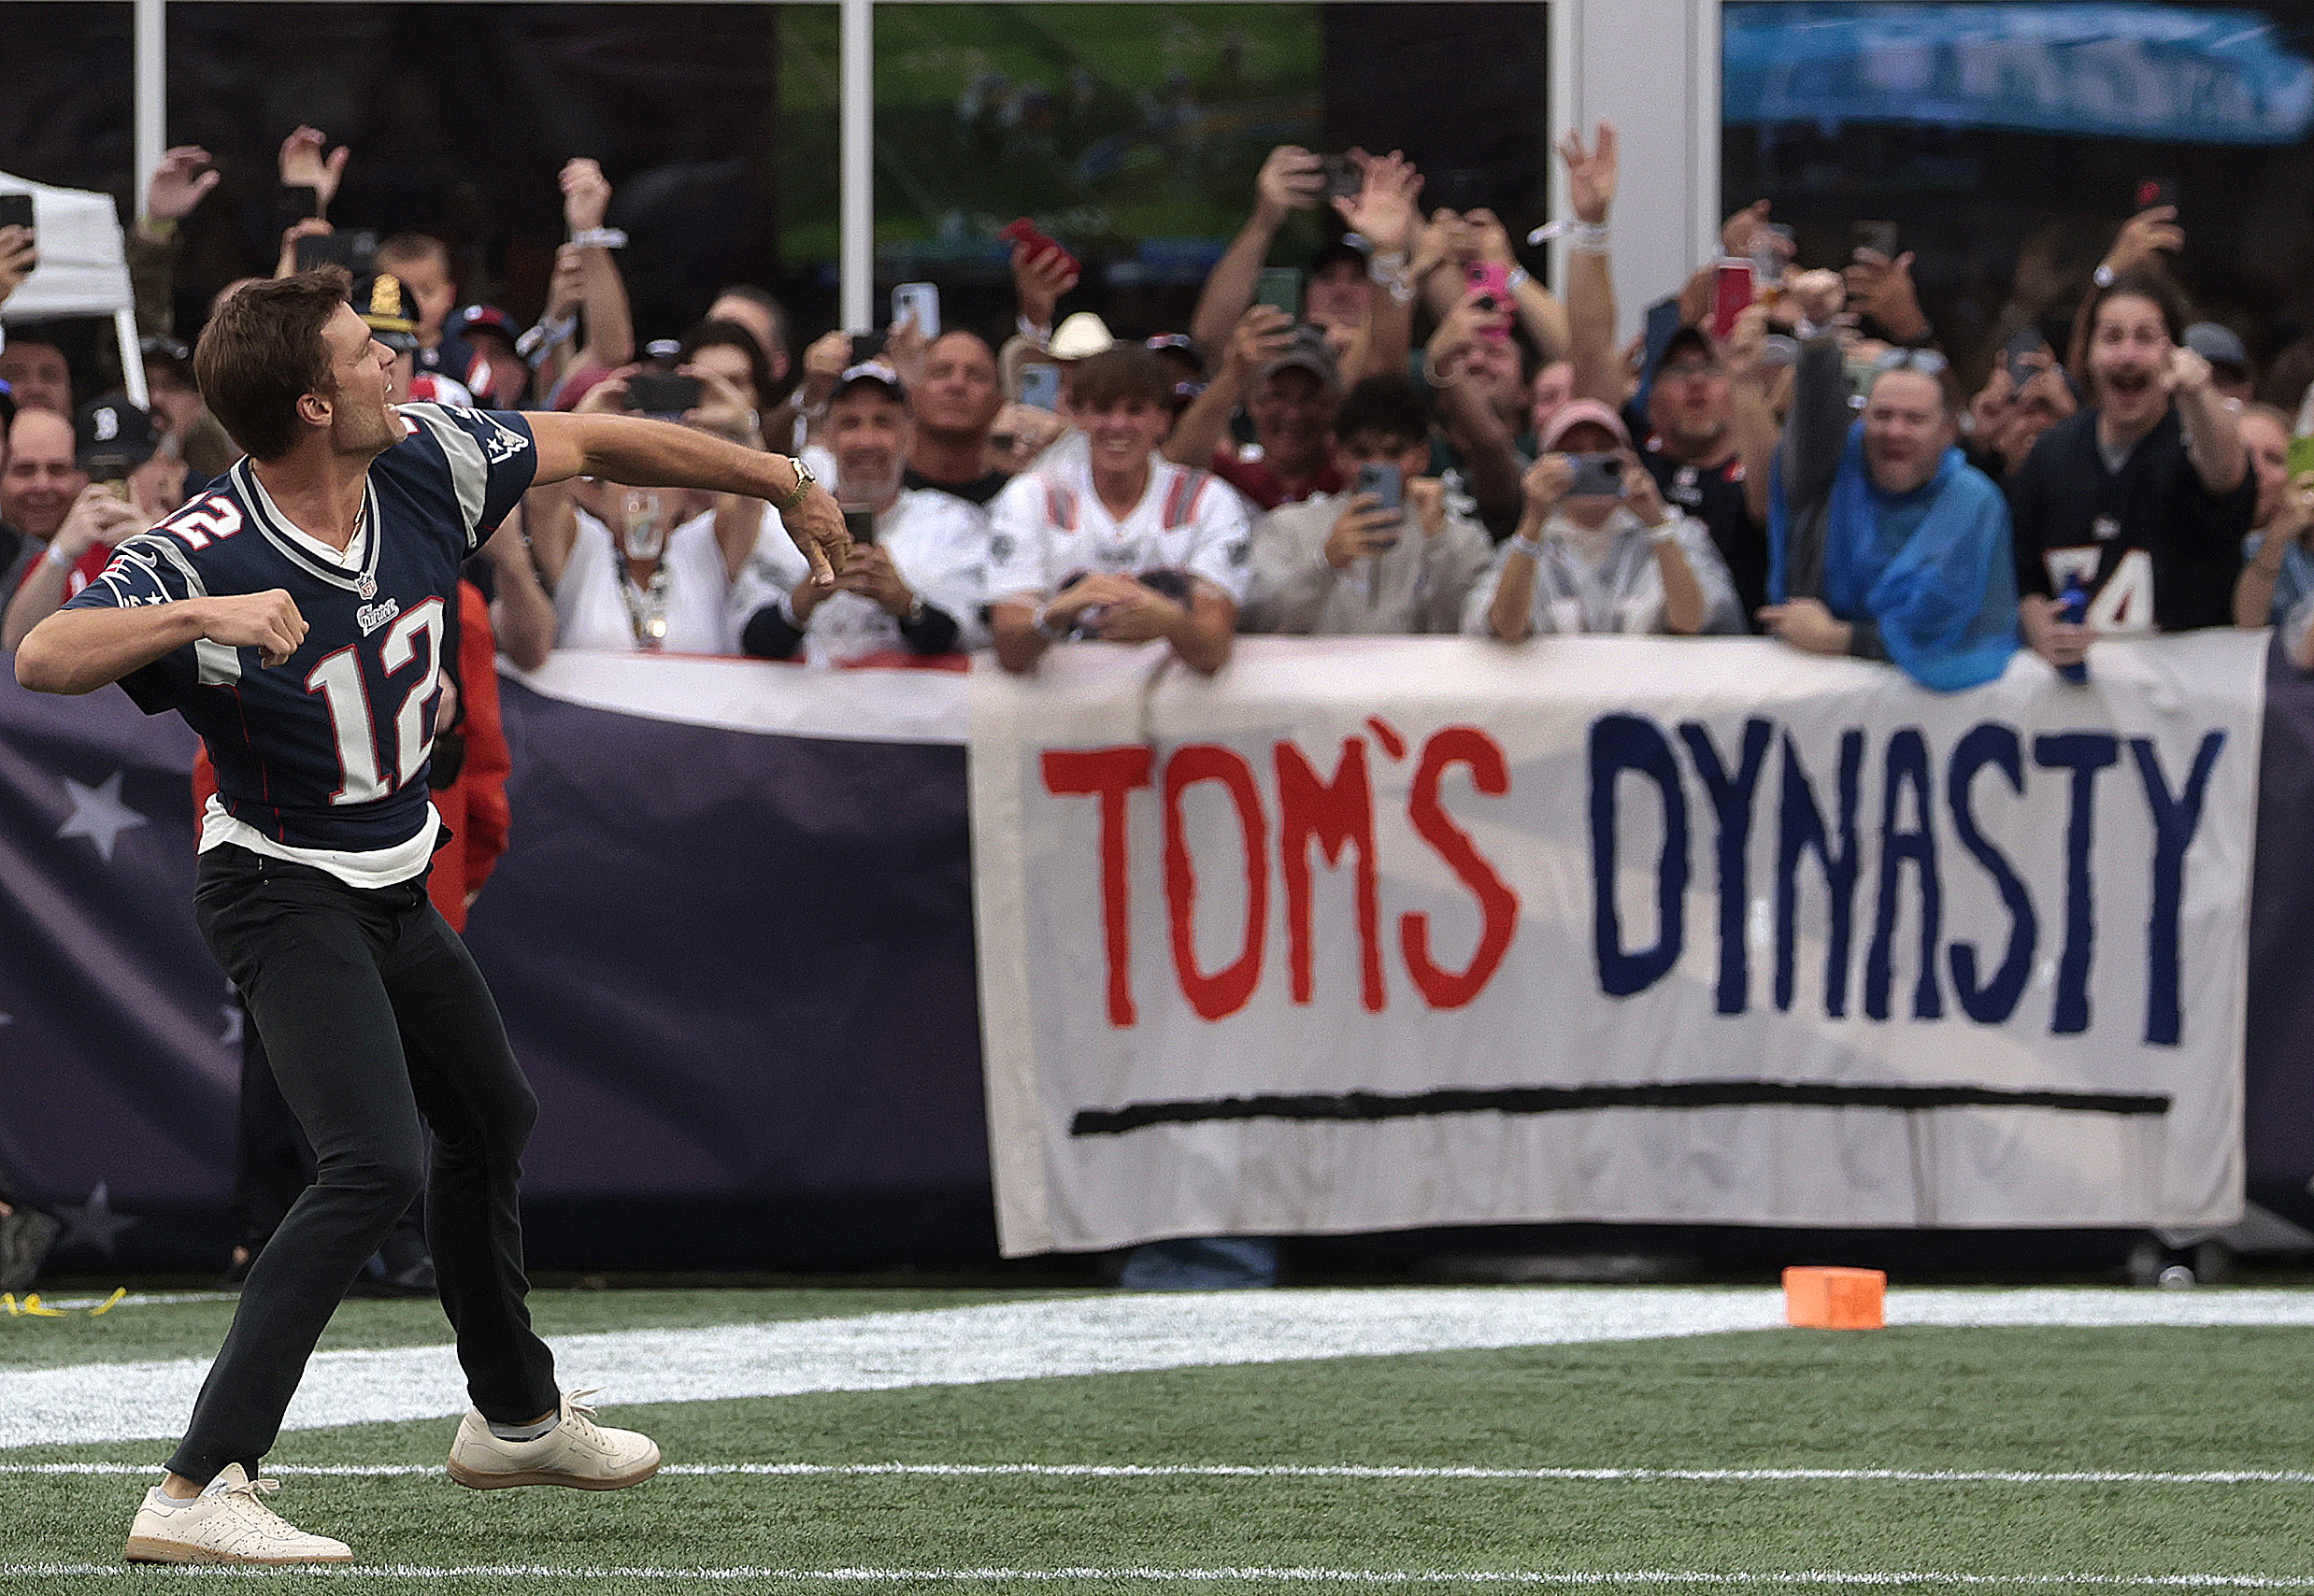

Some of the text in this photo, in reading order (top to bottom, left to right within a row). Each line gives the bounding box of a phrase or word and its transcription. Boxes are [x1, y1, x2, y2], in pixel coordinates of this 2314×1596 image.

[305, 595, 445, 805] 12
[1042, 711, 2226, 1047] TOM'S DYNASTY
